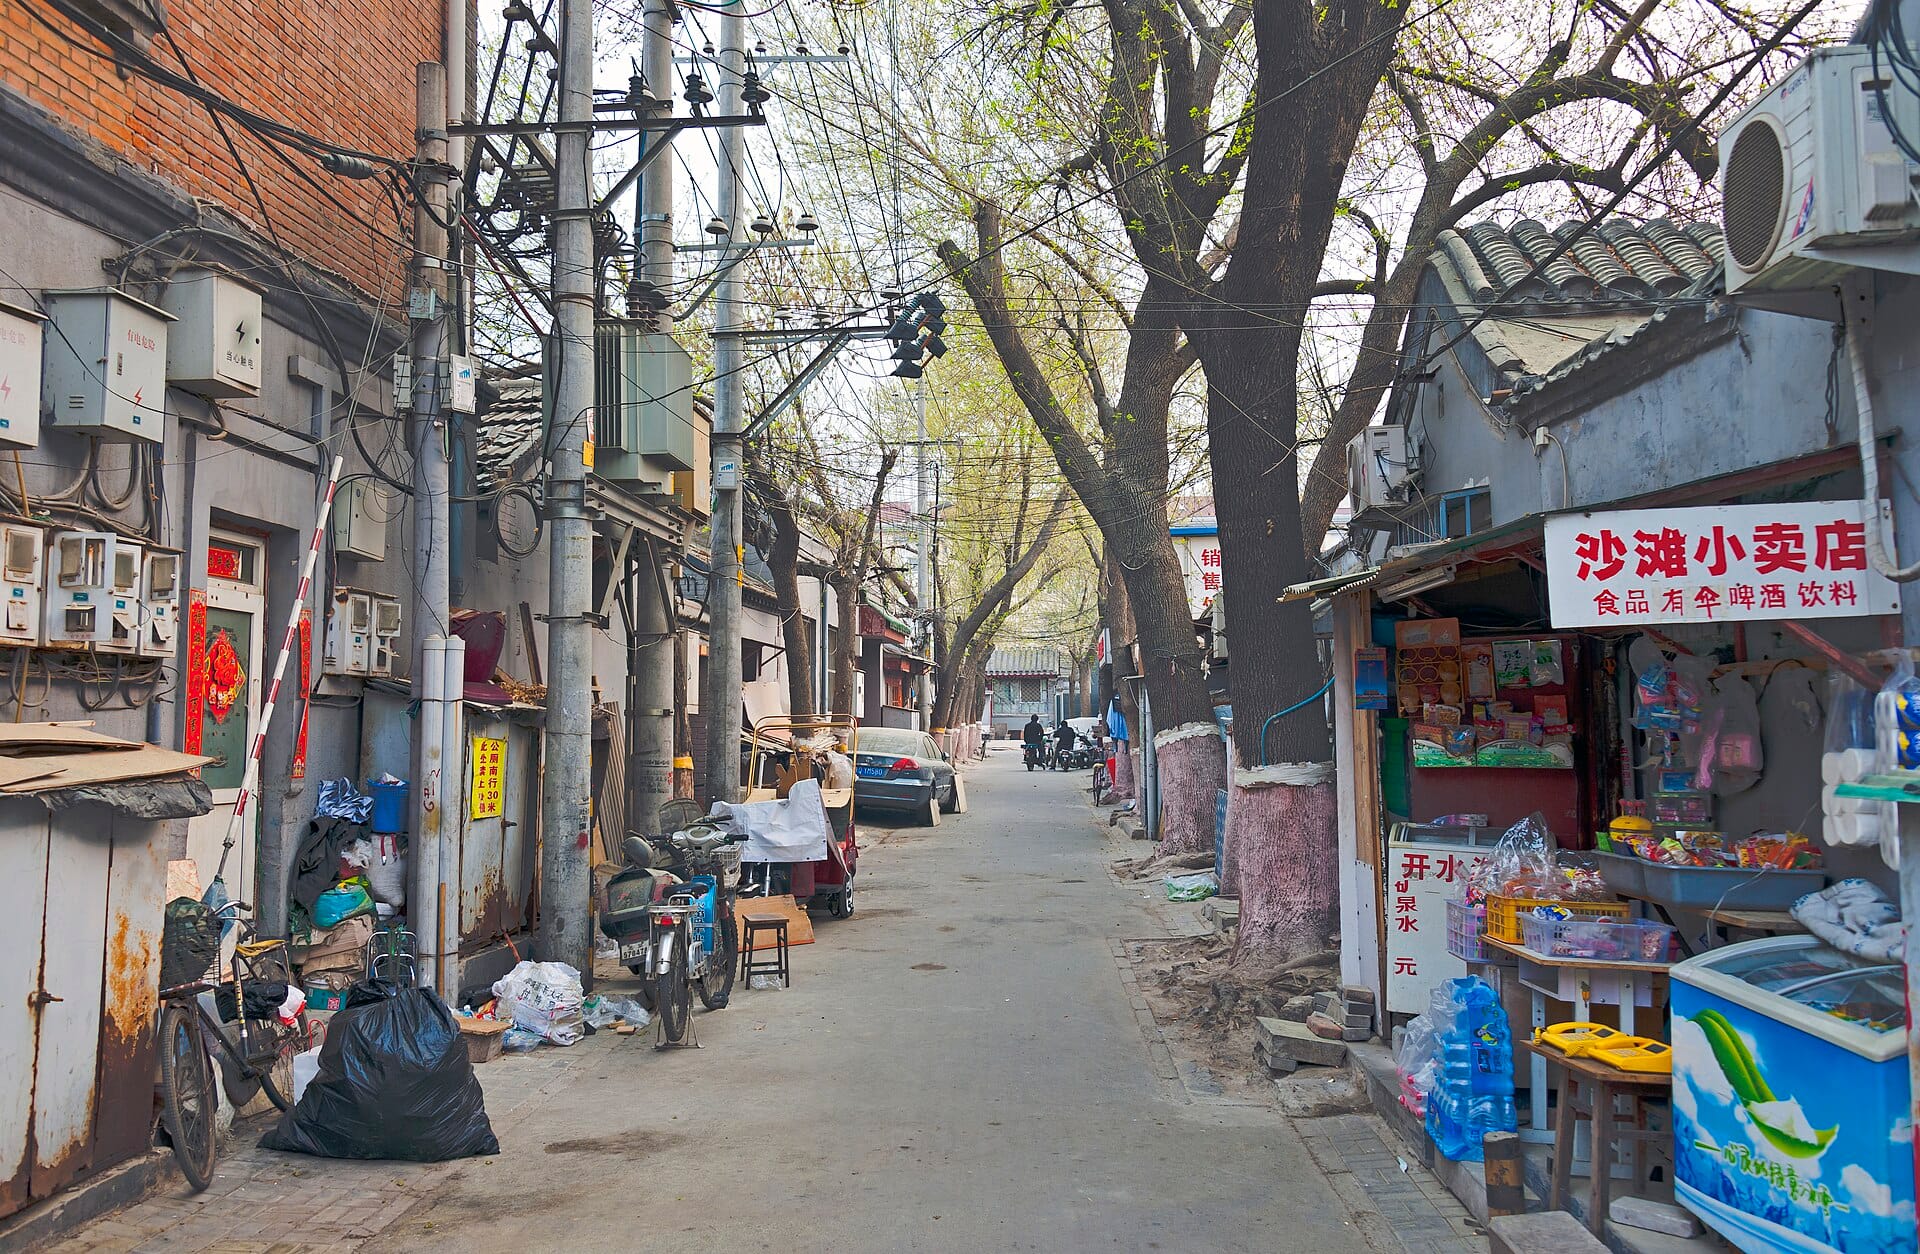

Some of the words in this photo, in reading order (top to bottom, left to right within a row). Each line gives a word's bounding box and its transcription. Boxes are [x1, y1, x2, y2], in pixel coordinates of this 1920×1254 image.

[226, 350, 254, 370] 当心触电
[1575, 519, 1868, 582] 沙滩小卖店
[1593, 588, 1650, 616] 食品
[1729, 583, 1786, 612] 啤酒
[1797, 580, 1857, 608] 饮料
[487, 741, 501, 813] 公厕南行30米
[1394, 957, 1418, 976] 元
